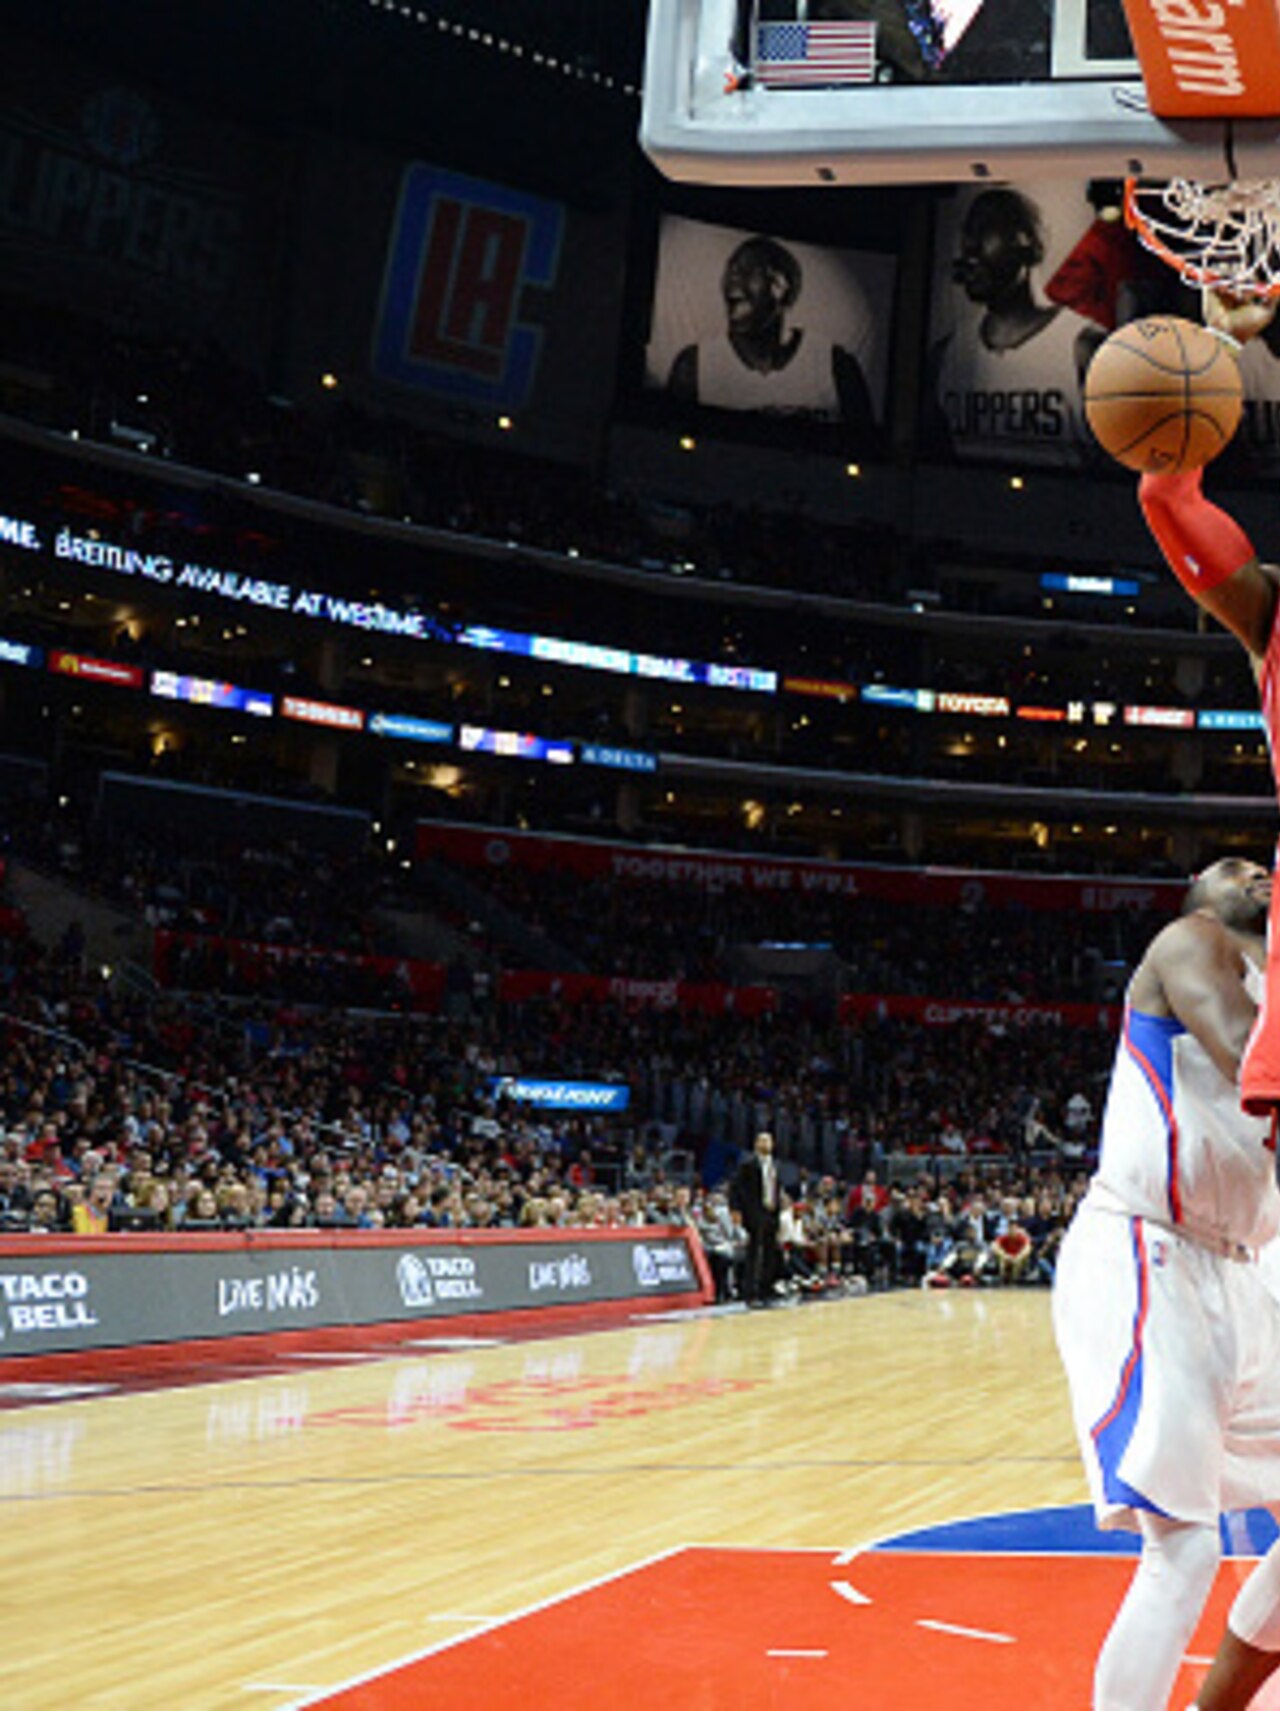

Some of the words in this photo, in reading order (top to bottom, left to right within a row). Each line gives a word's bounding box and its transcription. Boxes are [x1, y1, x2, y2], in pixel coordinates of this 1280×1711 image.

[1148, 0, 1246, 96] arm
[175, 563, 291, 609] AVAILABLE
[291, 589, 326, 617] AT
[426, 1256, 476, 1278] TACO
[0, 1270, 89, 1300] TACO
[217, 1278, 265, 1316] LIVE
[433, 1278, 484, 1300] BELL
[8, 1301, 98, 1332] BELL
